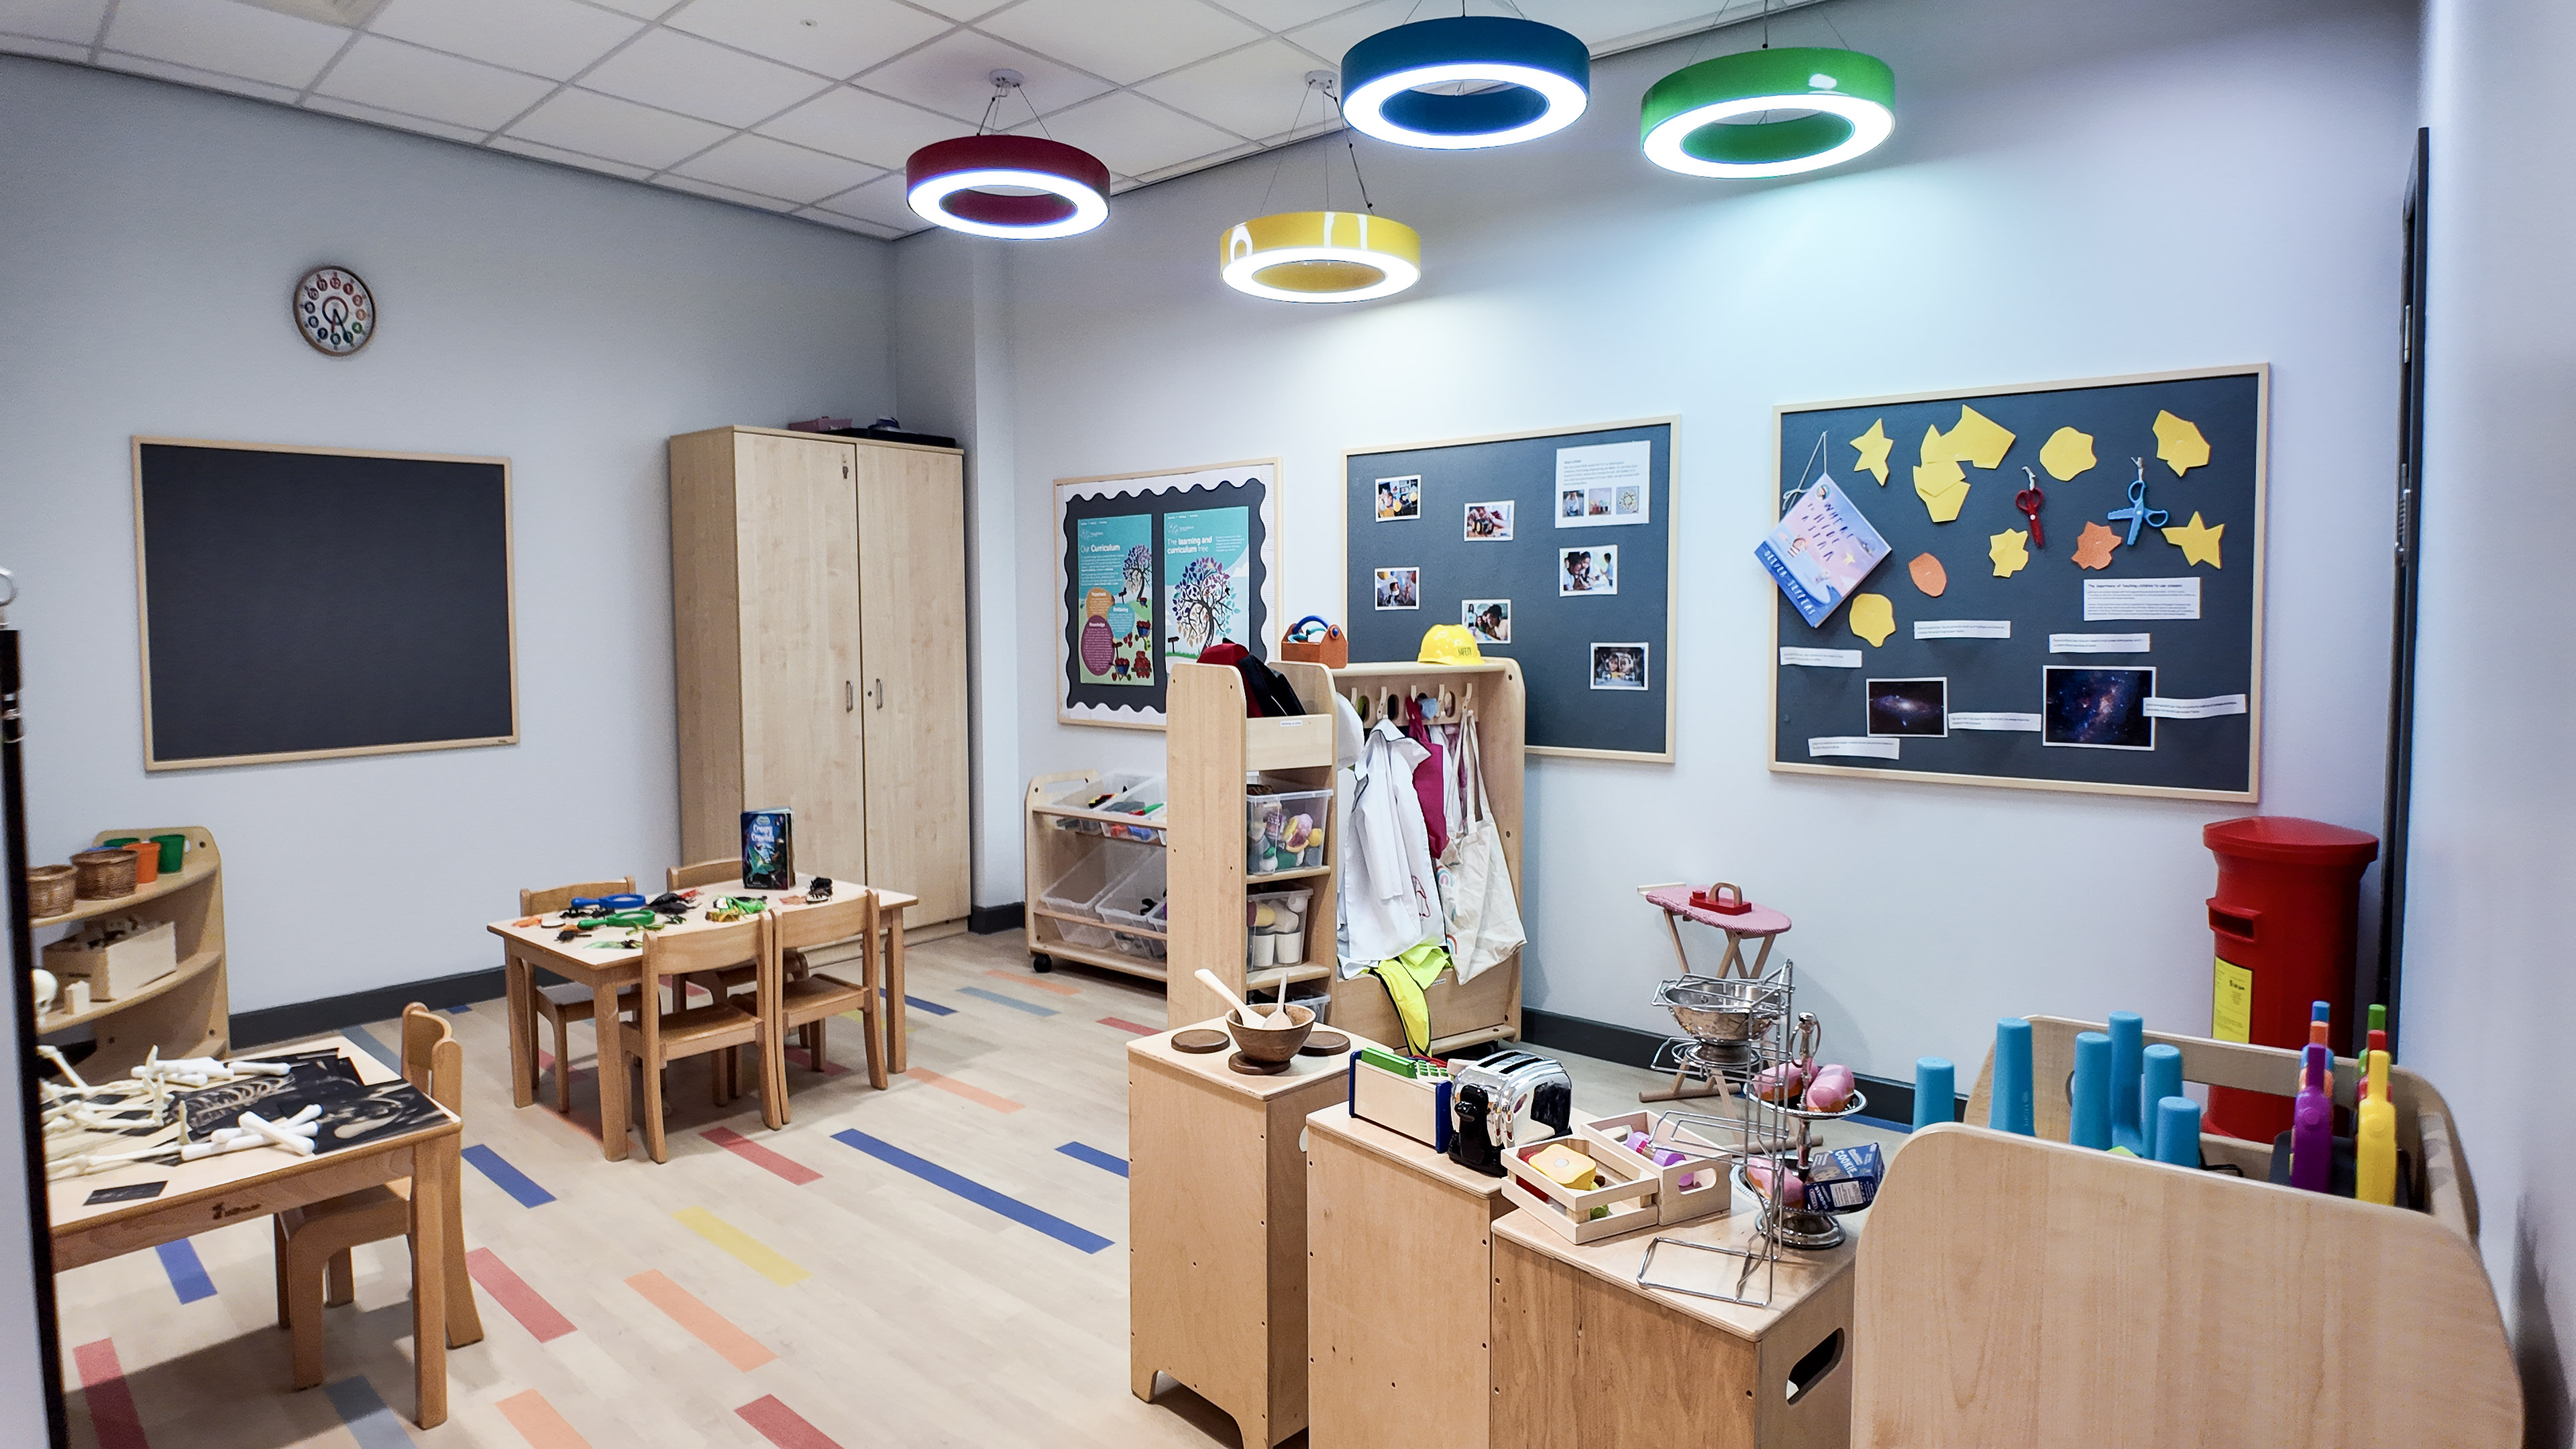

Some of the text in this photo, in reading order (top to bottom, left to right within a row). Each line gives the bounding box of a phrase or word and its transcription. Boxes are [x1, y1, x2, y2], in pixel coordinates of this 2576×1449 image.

[1167, 538, 1177, 546] The
[1178, 537, 1201, 545] learning
[1201, 536, 1212, 544] and
[1090, 544, 1120, 552] Curriculum
[1167, 545, 1197, 555] curriculum
[1835, 1150, 1858, 1176] COOKIE
